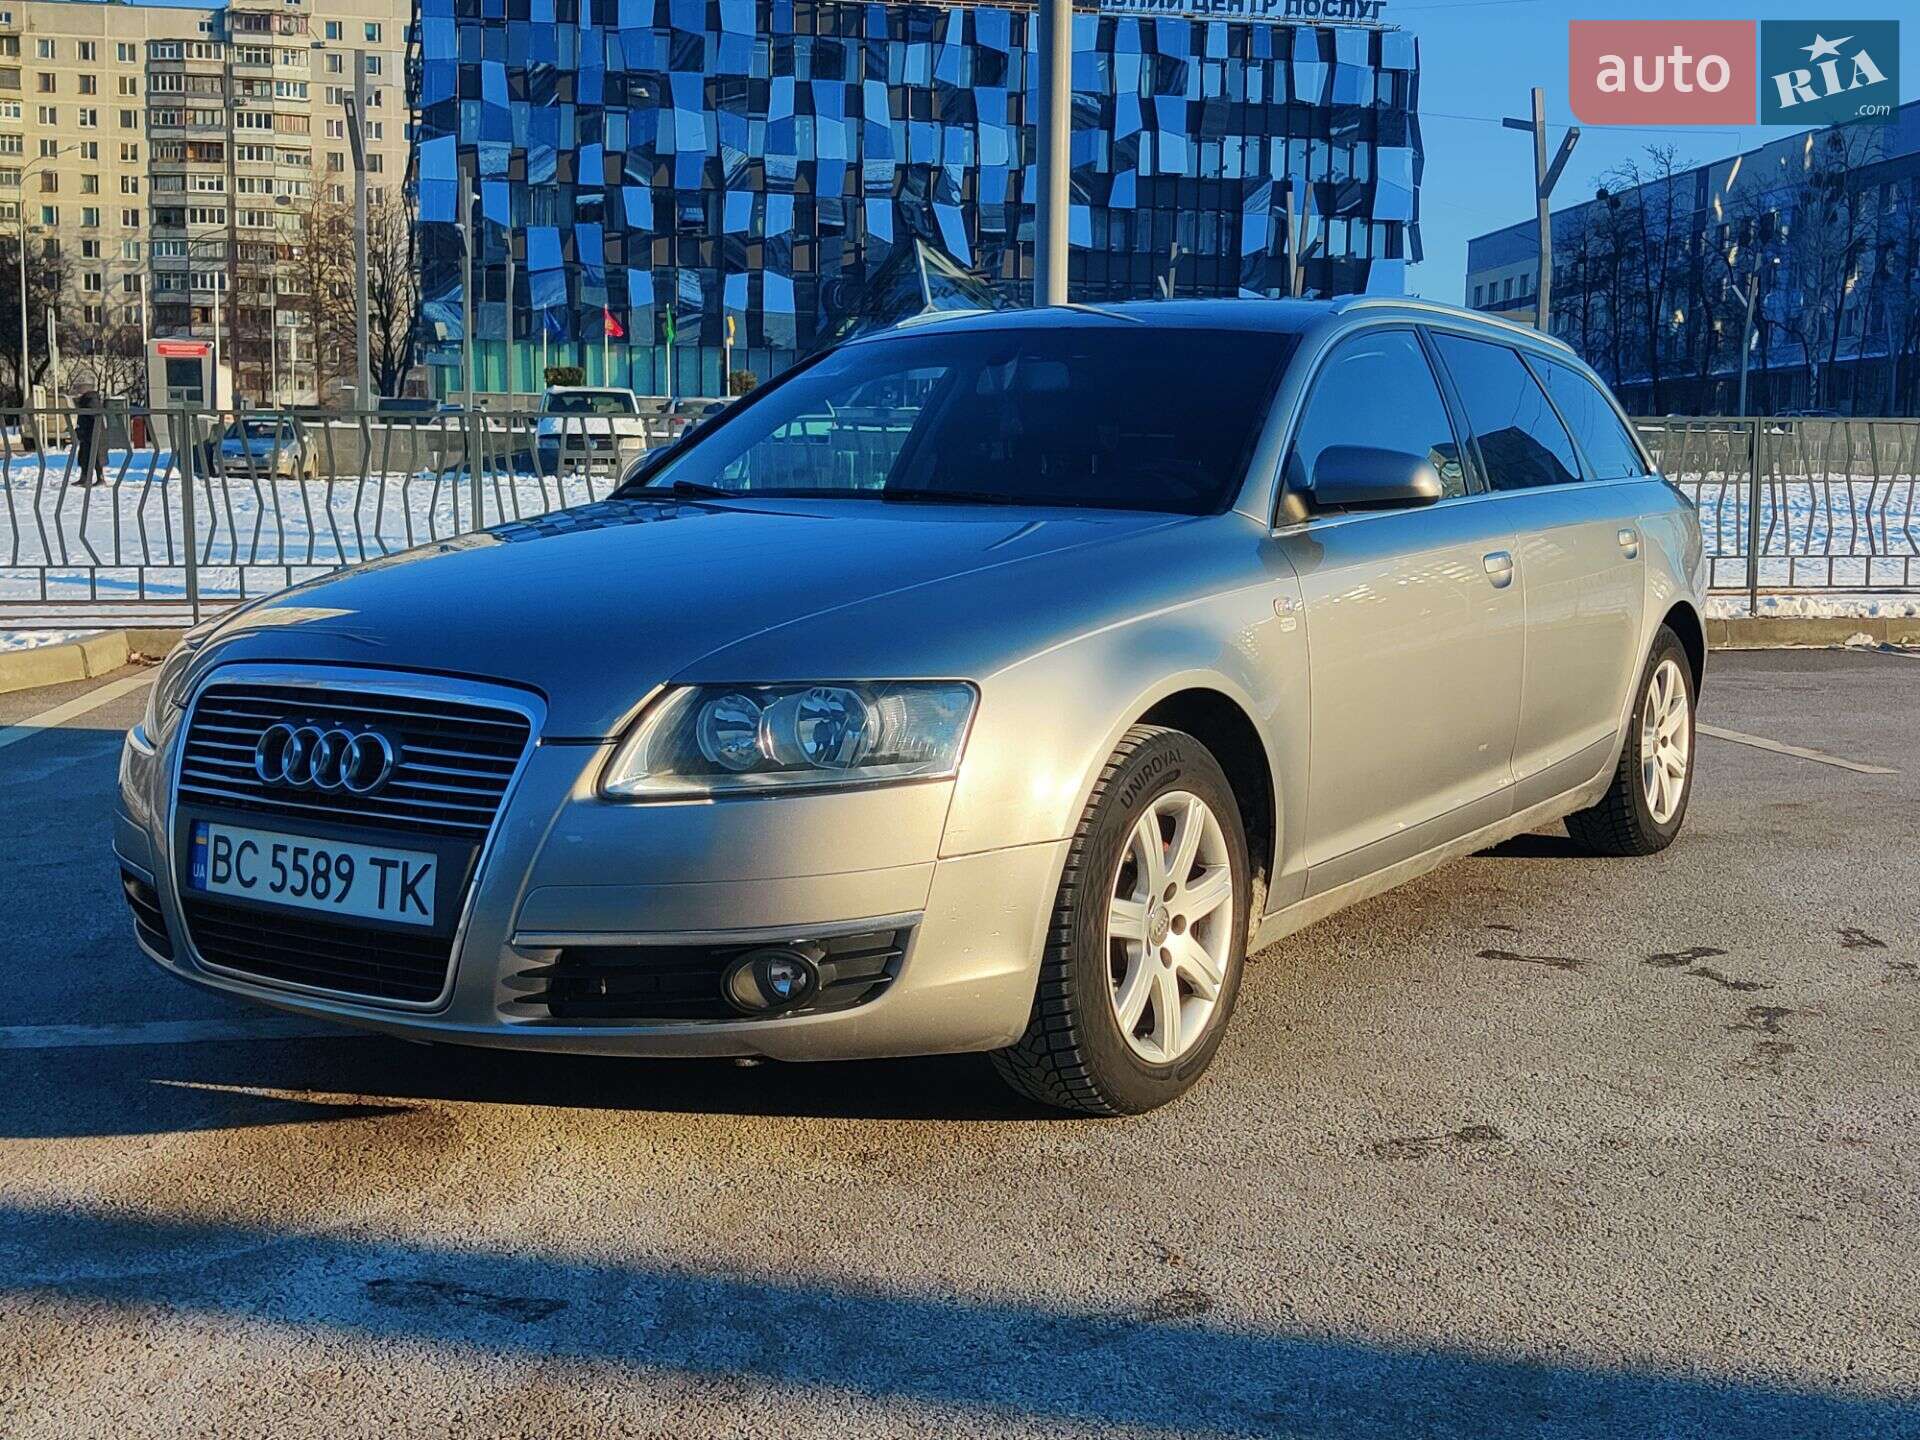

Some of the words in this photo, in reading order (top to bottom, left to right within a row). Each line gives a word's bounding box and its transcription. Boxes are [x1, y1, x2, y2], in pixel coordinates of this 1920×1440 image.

[1284, 0, 1387, 19] ПОСЛУГ
[1120, 748, 1186, 809] UNIROYAL
[192, 862, 206, 879] UA
[211, 834, 259, 888] BC
[269, 843, 355, 903] 5589
[368, 857, 432, 916] TK
